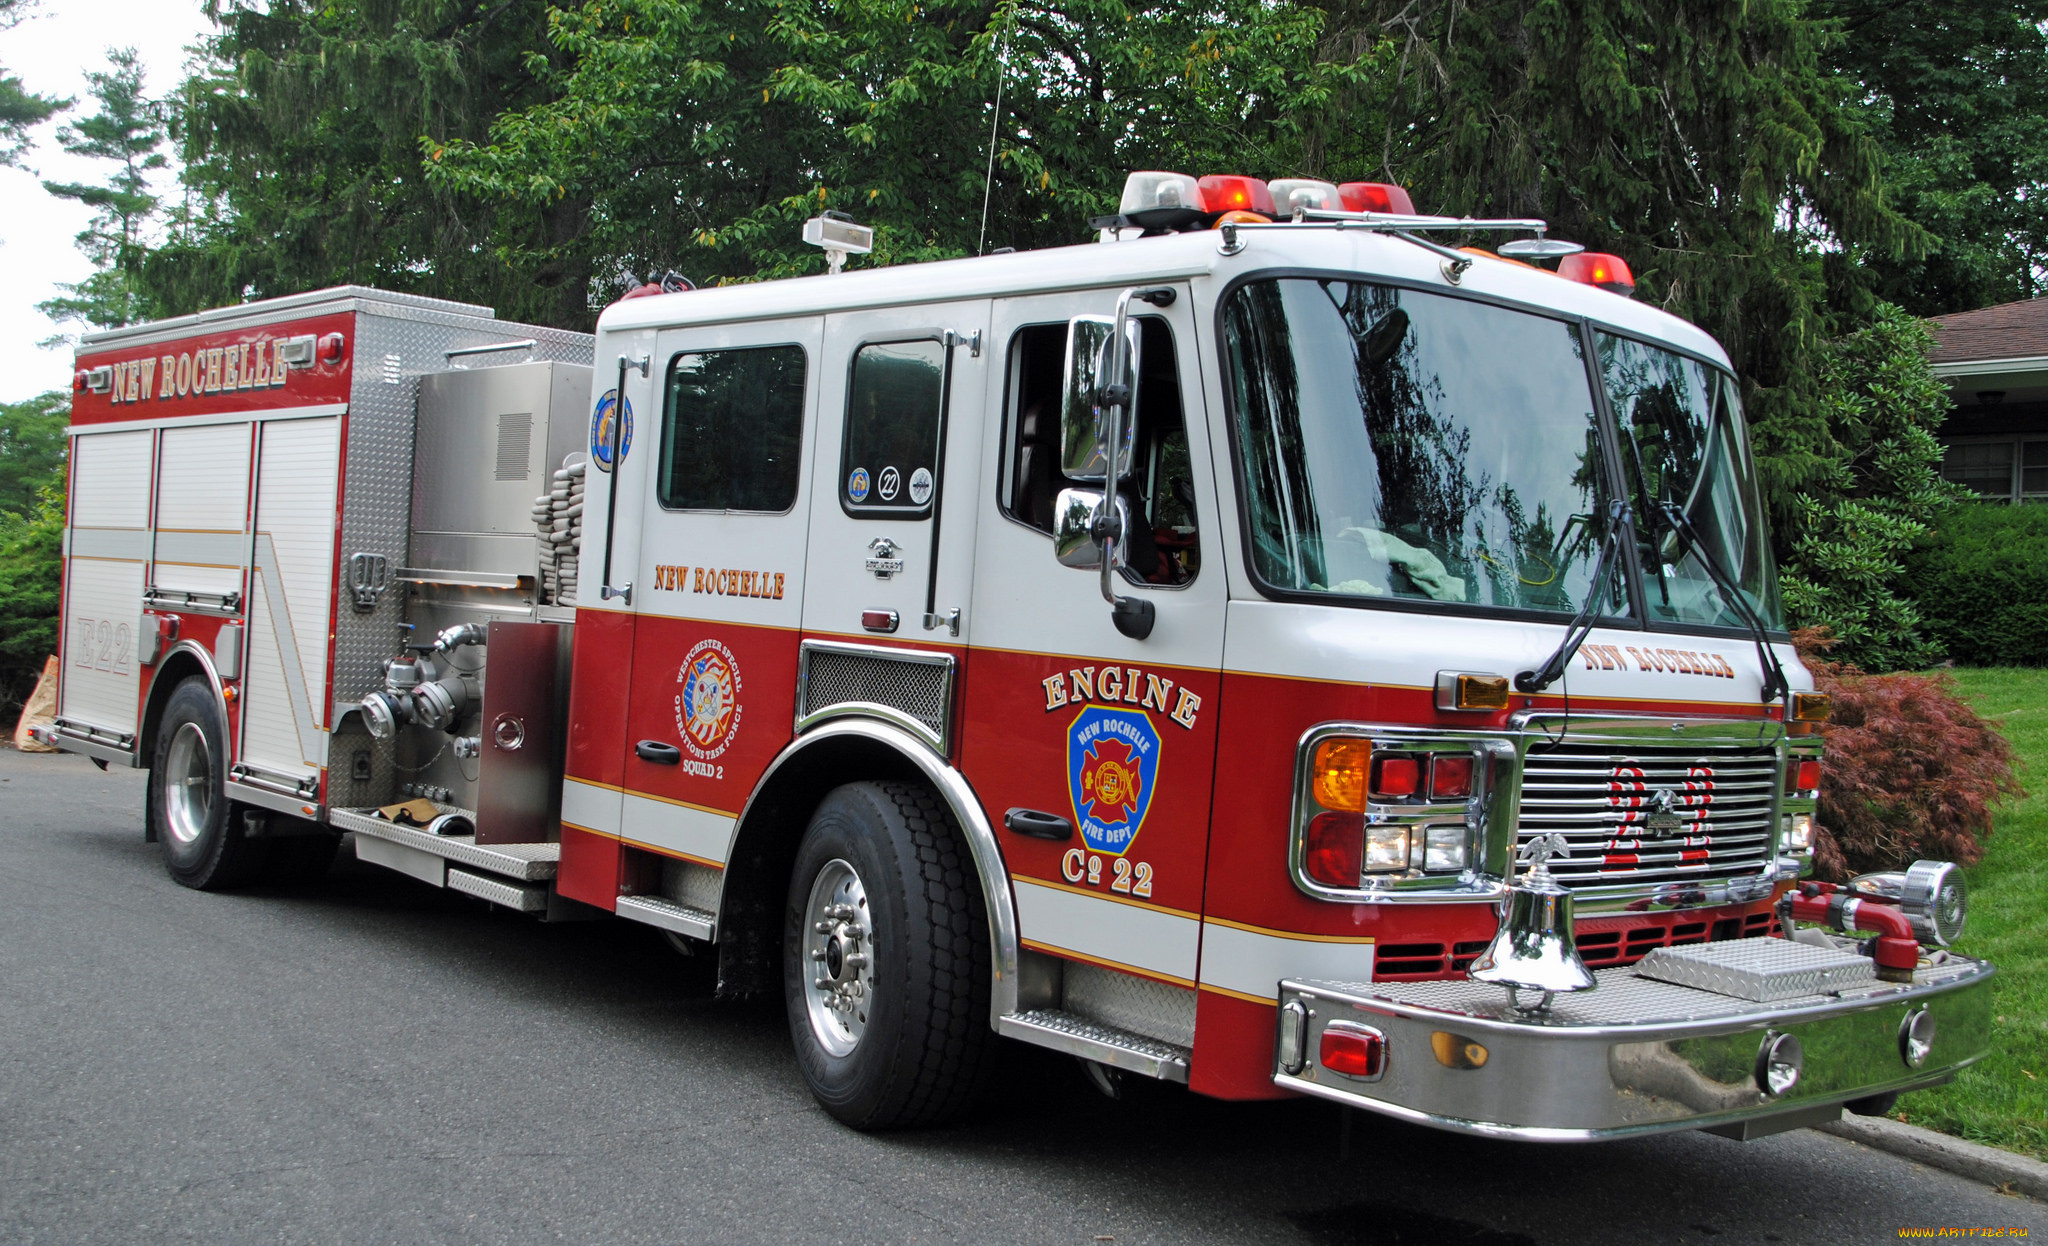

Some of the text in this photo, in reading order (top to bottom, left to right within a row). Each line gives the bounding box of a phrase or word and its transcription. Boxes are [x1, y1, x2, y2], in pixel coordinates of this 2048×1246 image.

[111, 337, 289, 405] NEW ROCHELLE
[881, 473, 897, 494] 22
[654, 565, 785, 600] NEW ROCHELLE
[75, 617, 132, 675] E22
[1578, 644, 1735, 679] NEW ROCHELLE
[677, 639, 743, 693] WESTCHESTER SPECIAL
[1041, 666, 1202, 730] ENGINE
[675, 695, 743, 760] OPERATIONS TASK FORCE
[1077, 718, 1151, 754] NEW ROCHELLE
[683, 759, 723, 779] SQUAD 2
[1081, 818, 1132, 843] FIRE DEPT
[1111, 857, 1153, 898] 22
